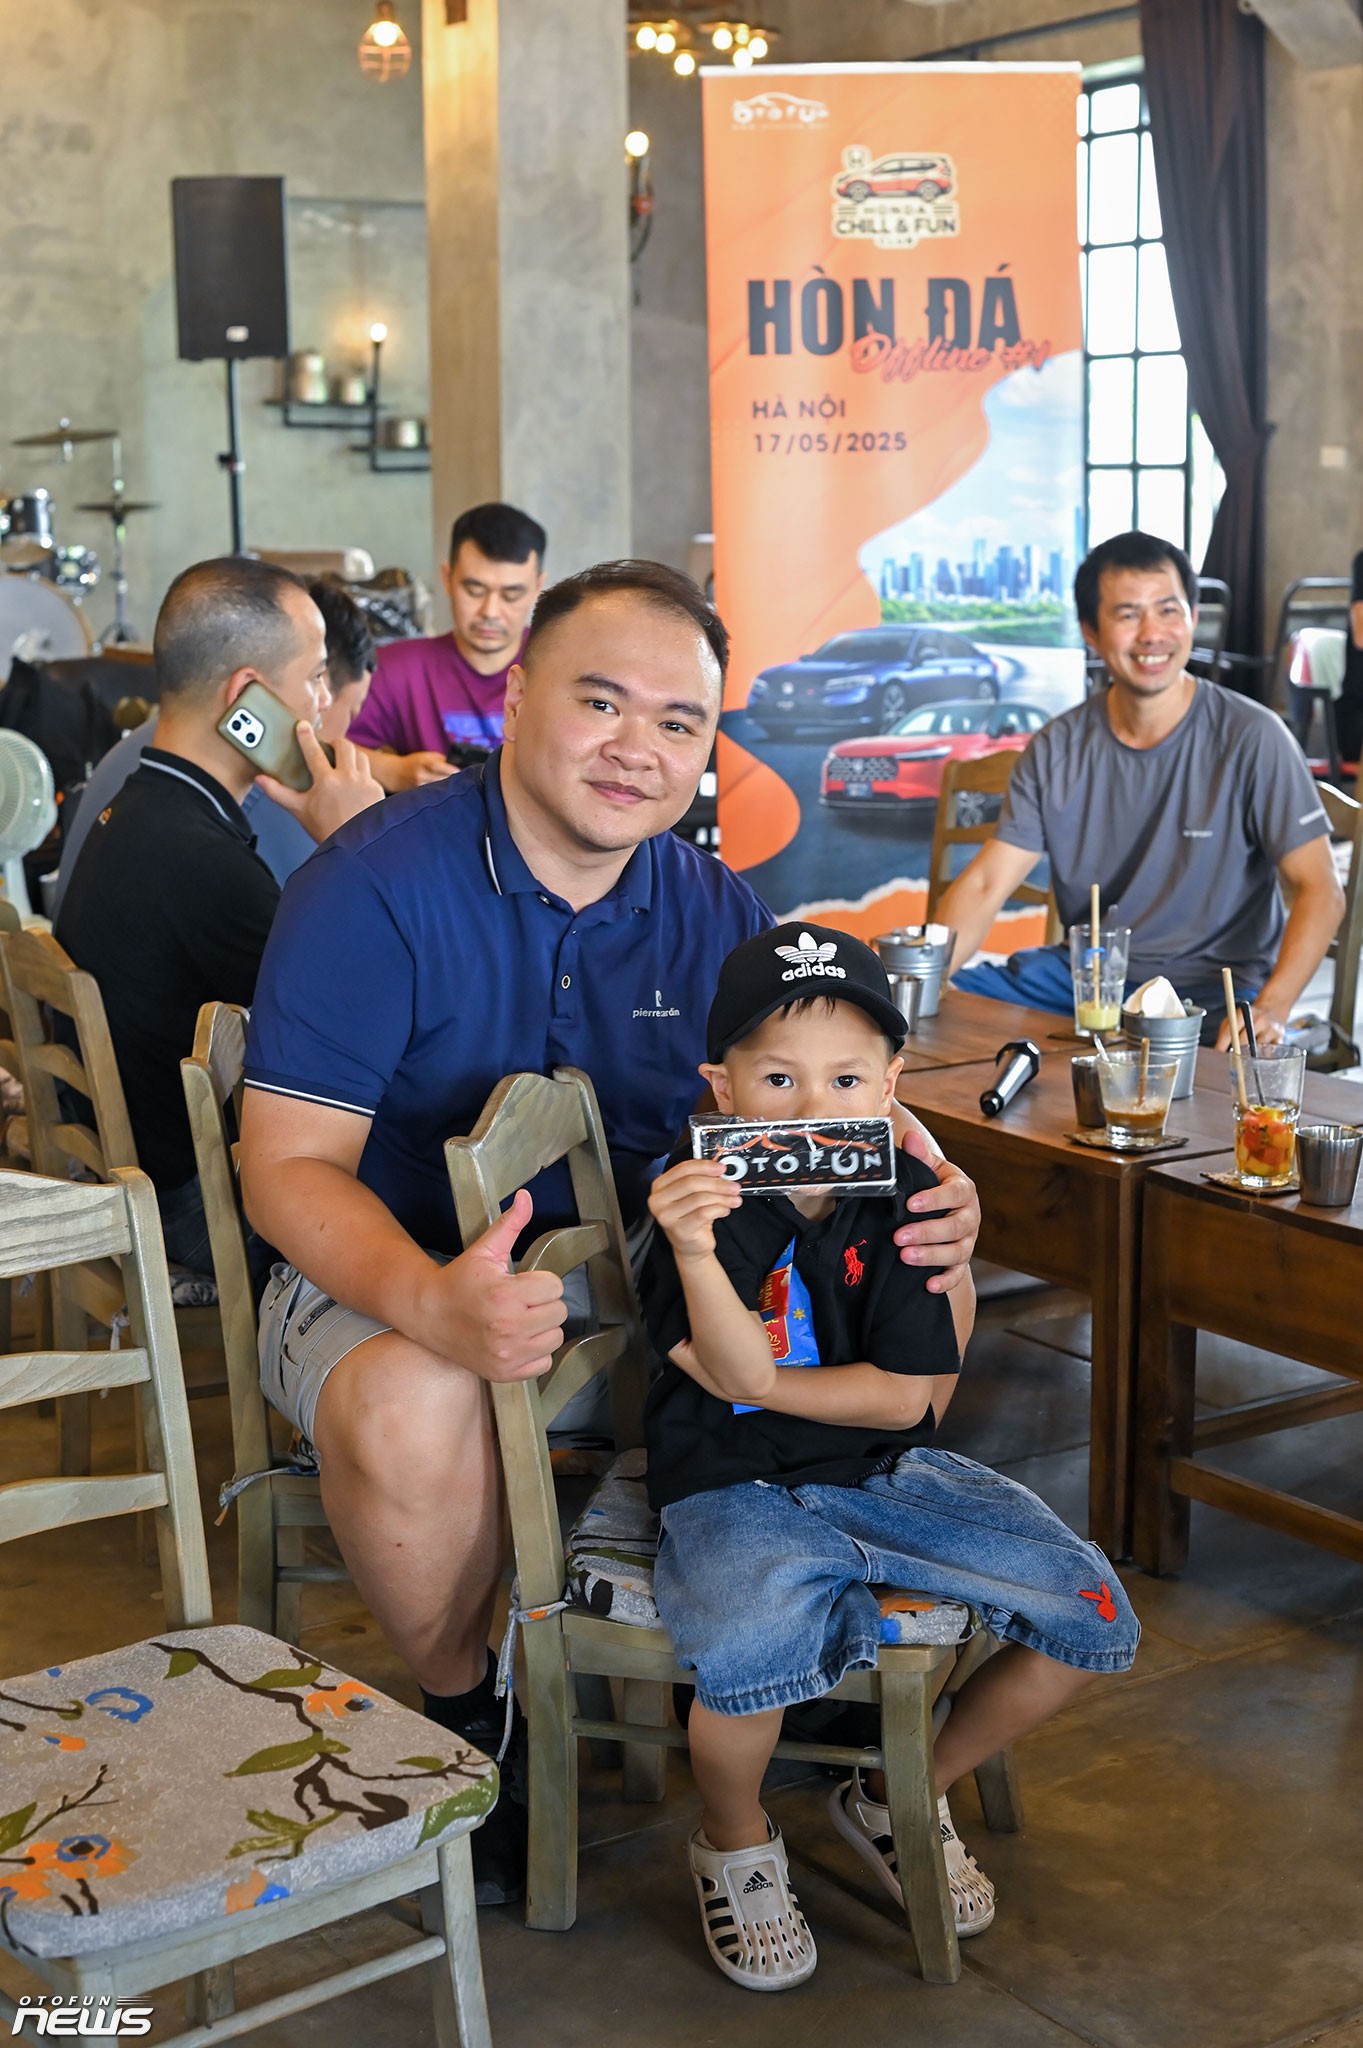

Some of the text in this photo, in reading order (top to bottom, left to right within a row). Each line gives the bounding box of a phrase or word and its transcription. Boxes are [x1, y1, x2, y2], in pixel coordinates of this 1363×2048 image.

[836, 218, 956, 234] CHILL & FUN
[747, 263, 1022, 356] HÒN ĐÁ
[851, 331, 1051, 382] Offline #1
[752, 393, 846, 424] HÀ NỘI
[754, 431, 907, 454] 17/05/2025
[781, 961, 847, 981] adidas
[717, 1150, 883, 1181] OTOFUN
[743, 1882, 774, 1894] adidas
